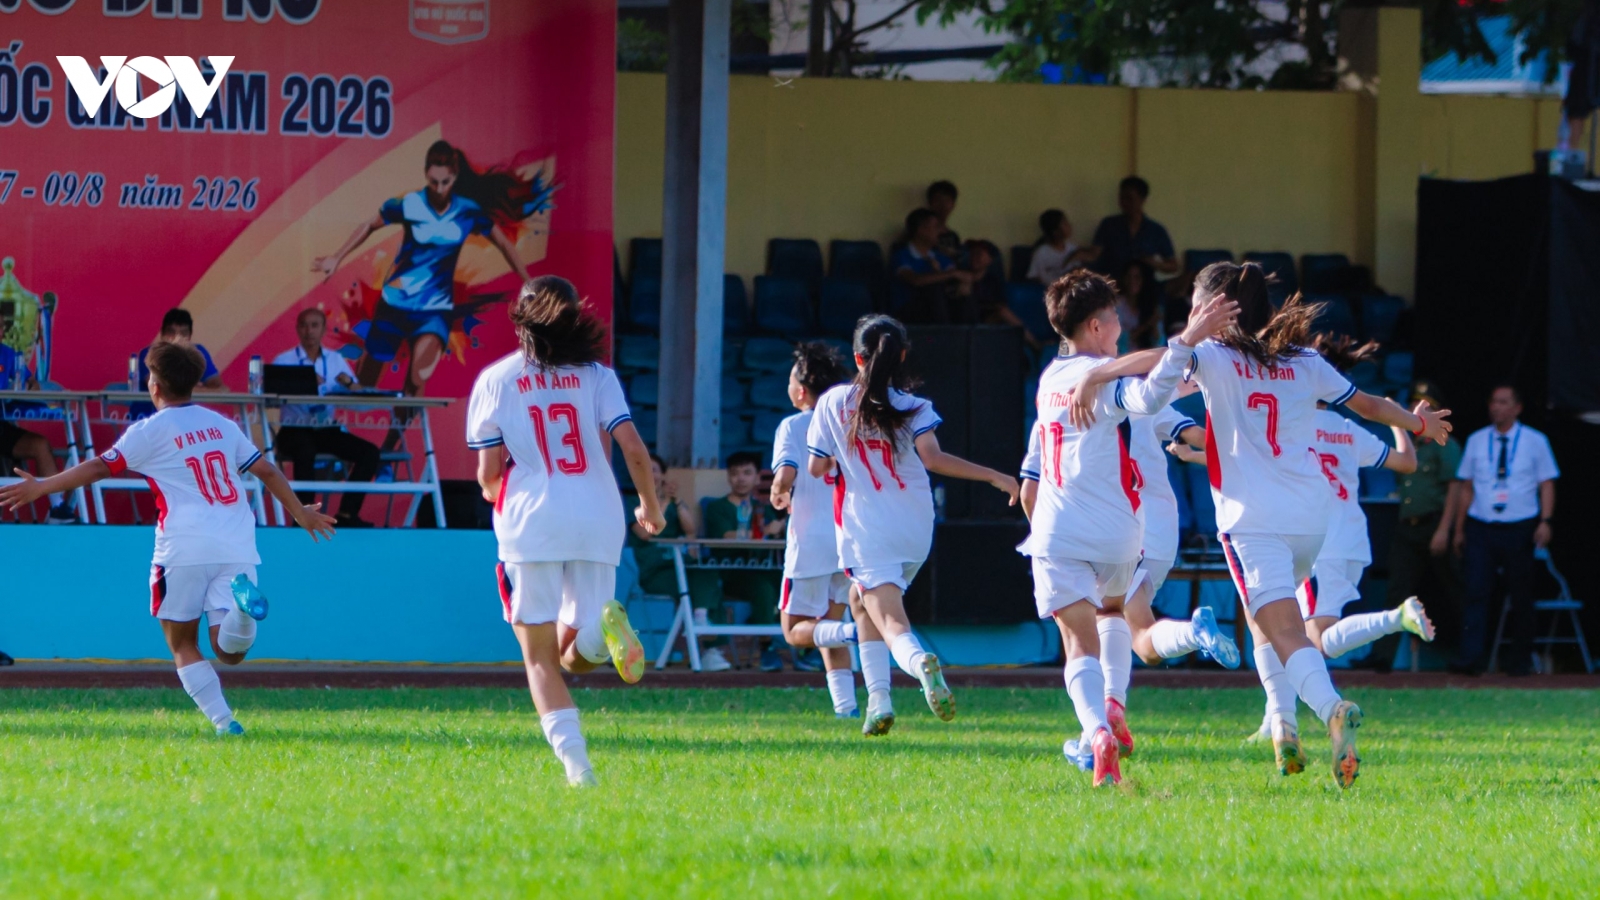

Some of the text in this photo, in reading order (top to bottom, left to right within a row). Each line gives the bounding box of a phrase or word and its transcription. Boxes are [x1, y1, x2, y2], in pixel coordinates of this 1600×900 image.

[280, 74, 394, 139] 2026
[0, 170, 19, 205] 7
[43, 171, 107, 208] 09/8
[118, 175, 184, 208] năm
[188, 176, 260, 211] 2026
[516, 374, 533, 394] M
[534, 372, 548, 390] N
[173, 426, 224, 451] V H N Hà
[526, 402, 590, 480] 13
[1247, 391, 1283, 461] 7
[183, 449, 240, 508] 10
[854, 435, 907, 492] 17
